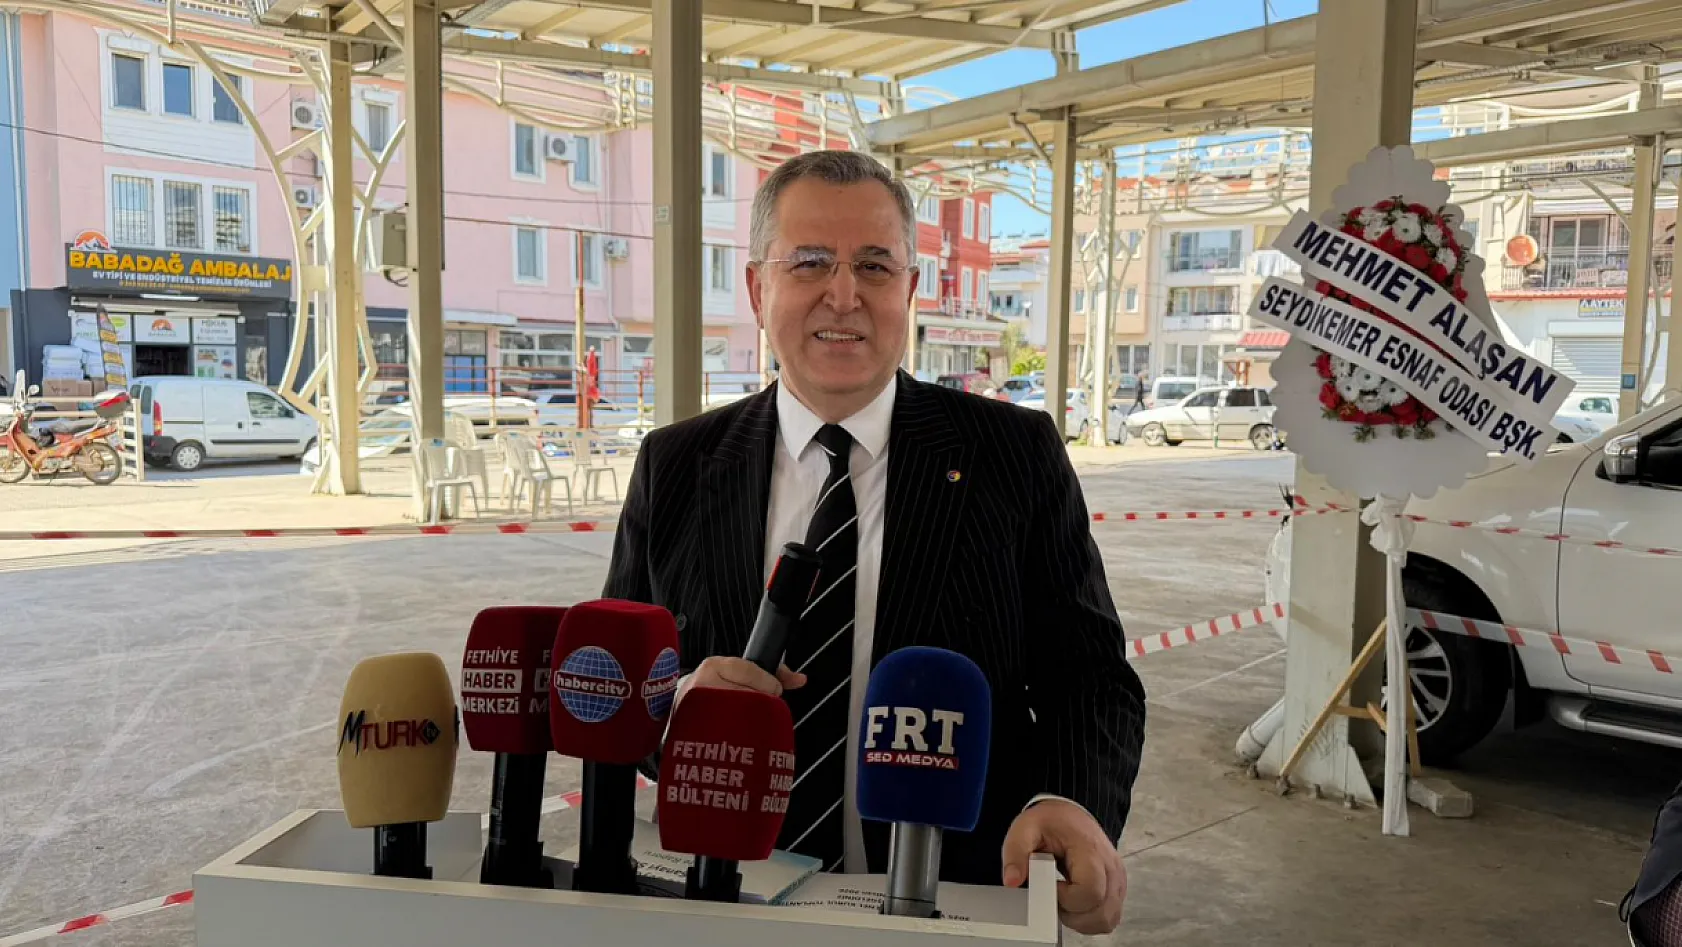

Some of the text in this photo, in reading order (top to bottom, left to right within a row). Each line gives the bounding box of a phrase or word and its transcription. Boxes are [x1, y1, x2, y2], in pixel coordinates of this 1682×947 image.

[69, 251, 292, 282] BABADAĞ AMBALAJ
[1293, 221, 1558, 404] MEHMET ALAŞAN
[1259, 285, 1544, 460] SEYDİKEMER ESNAF ODASI BŞK.
[466, 647, 519, 664] FETHİYE
[463, 672, 516, 690] HABER
[556, 674, 627, 696] habercity
[461, 696, 519, 714] MERKEZİ
[864, 706, 964, 755] FRT
[672, 740, 755, 765] FETHİYE
[866, 752, 956, 769] SED MEDYA
[673, 765, 744, 788] HABER
[666, 783, 750, 812] BÜLTENİ
